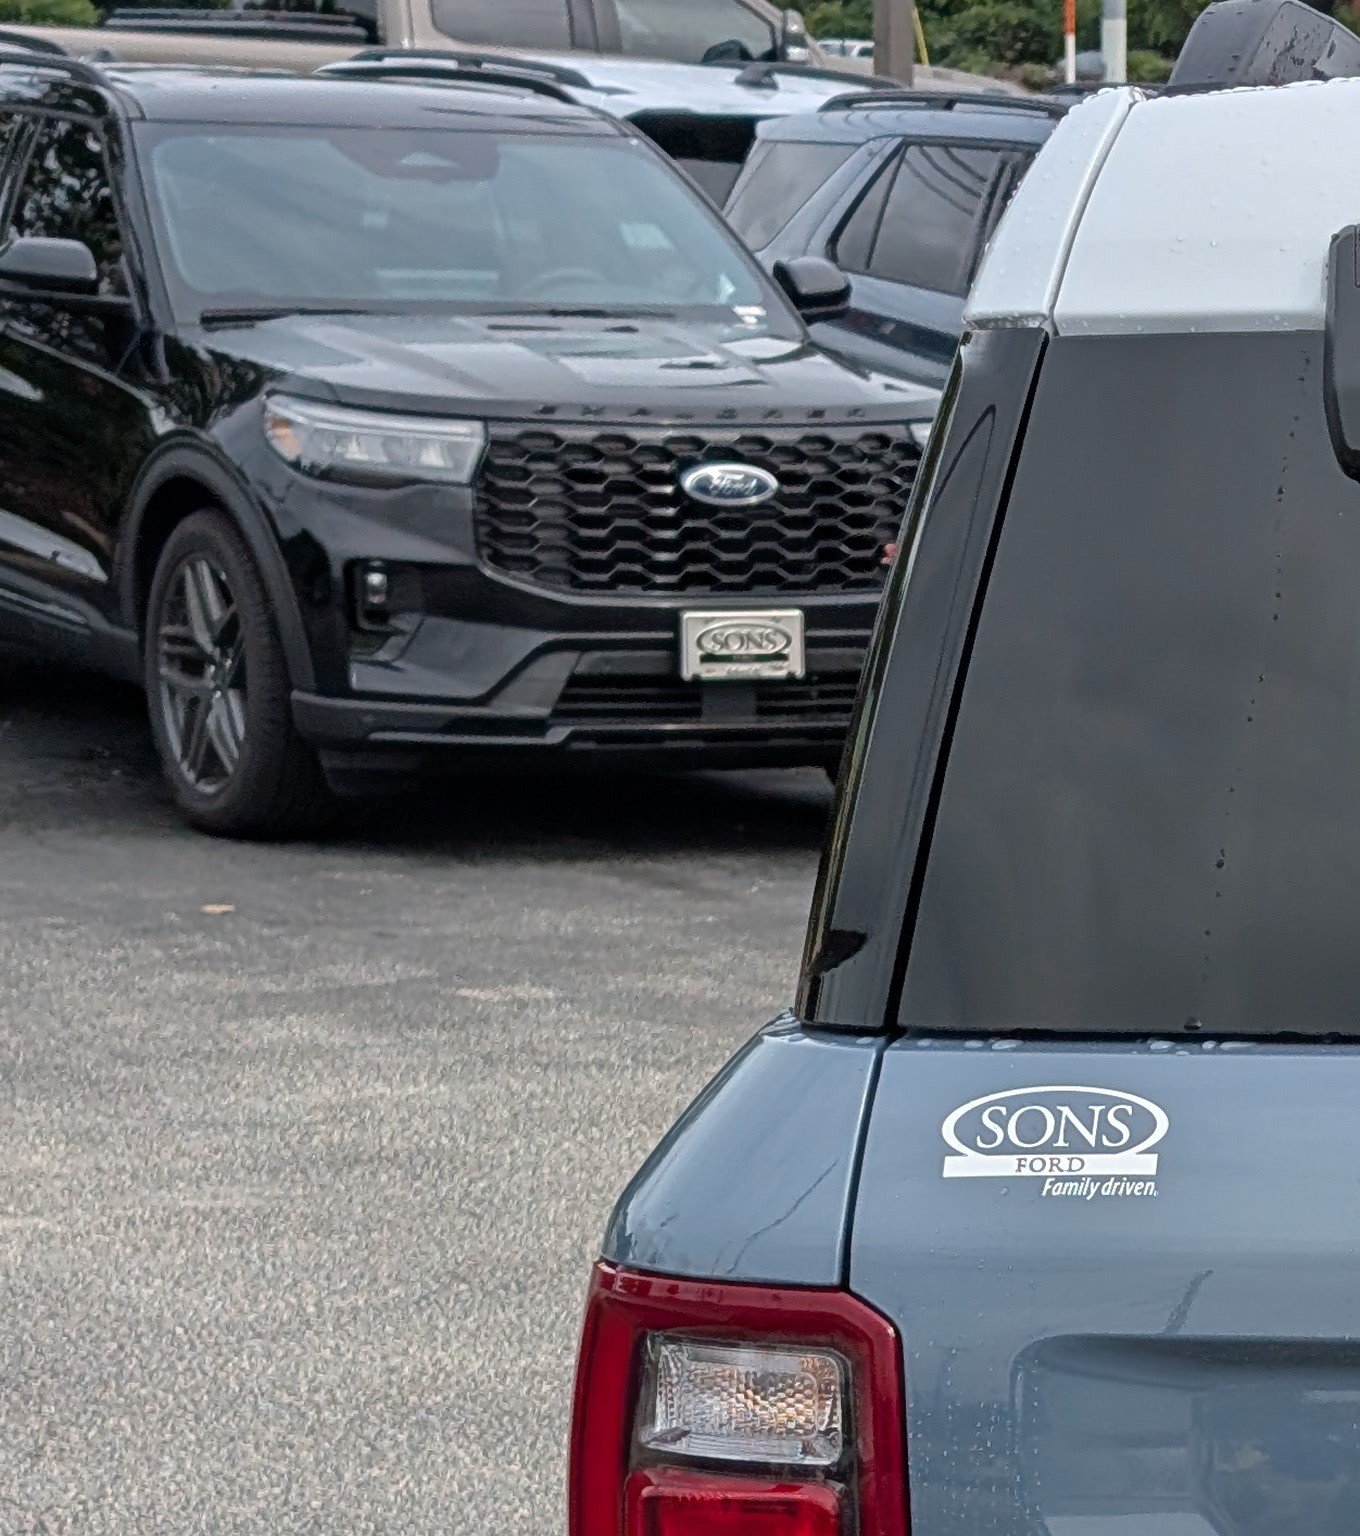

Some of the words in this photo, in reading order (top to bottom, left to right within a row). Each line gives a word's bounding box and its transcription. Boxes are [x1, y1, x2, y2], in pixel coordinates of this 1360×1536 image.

[711, 629, 779, 651] SONS
[976, 1105, 1133, 1148] SONS
[1015, 1157, 1085, 1173] FORD
[1041, 1177, 1101, 1200] Family
